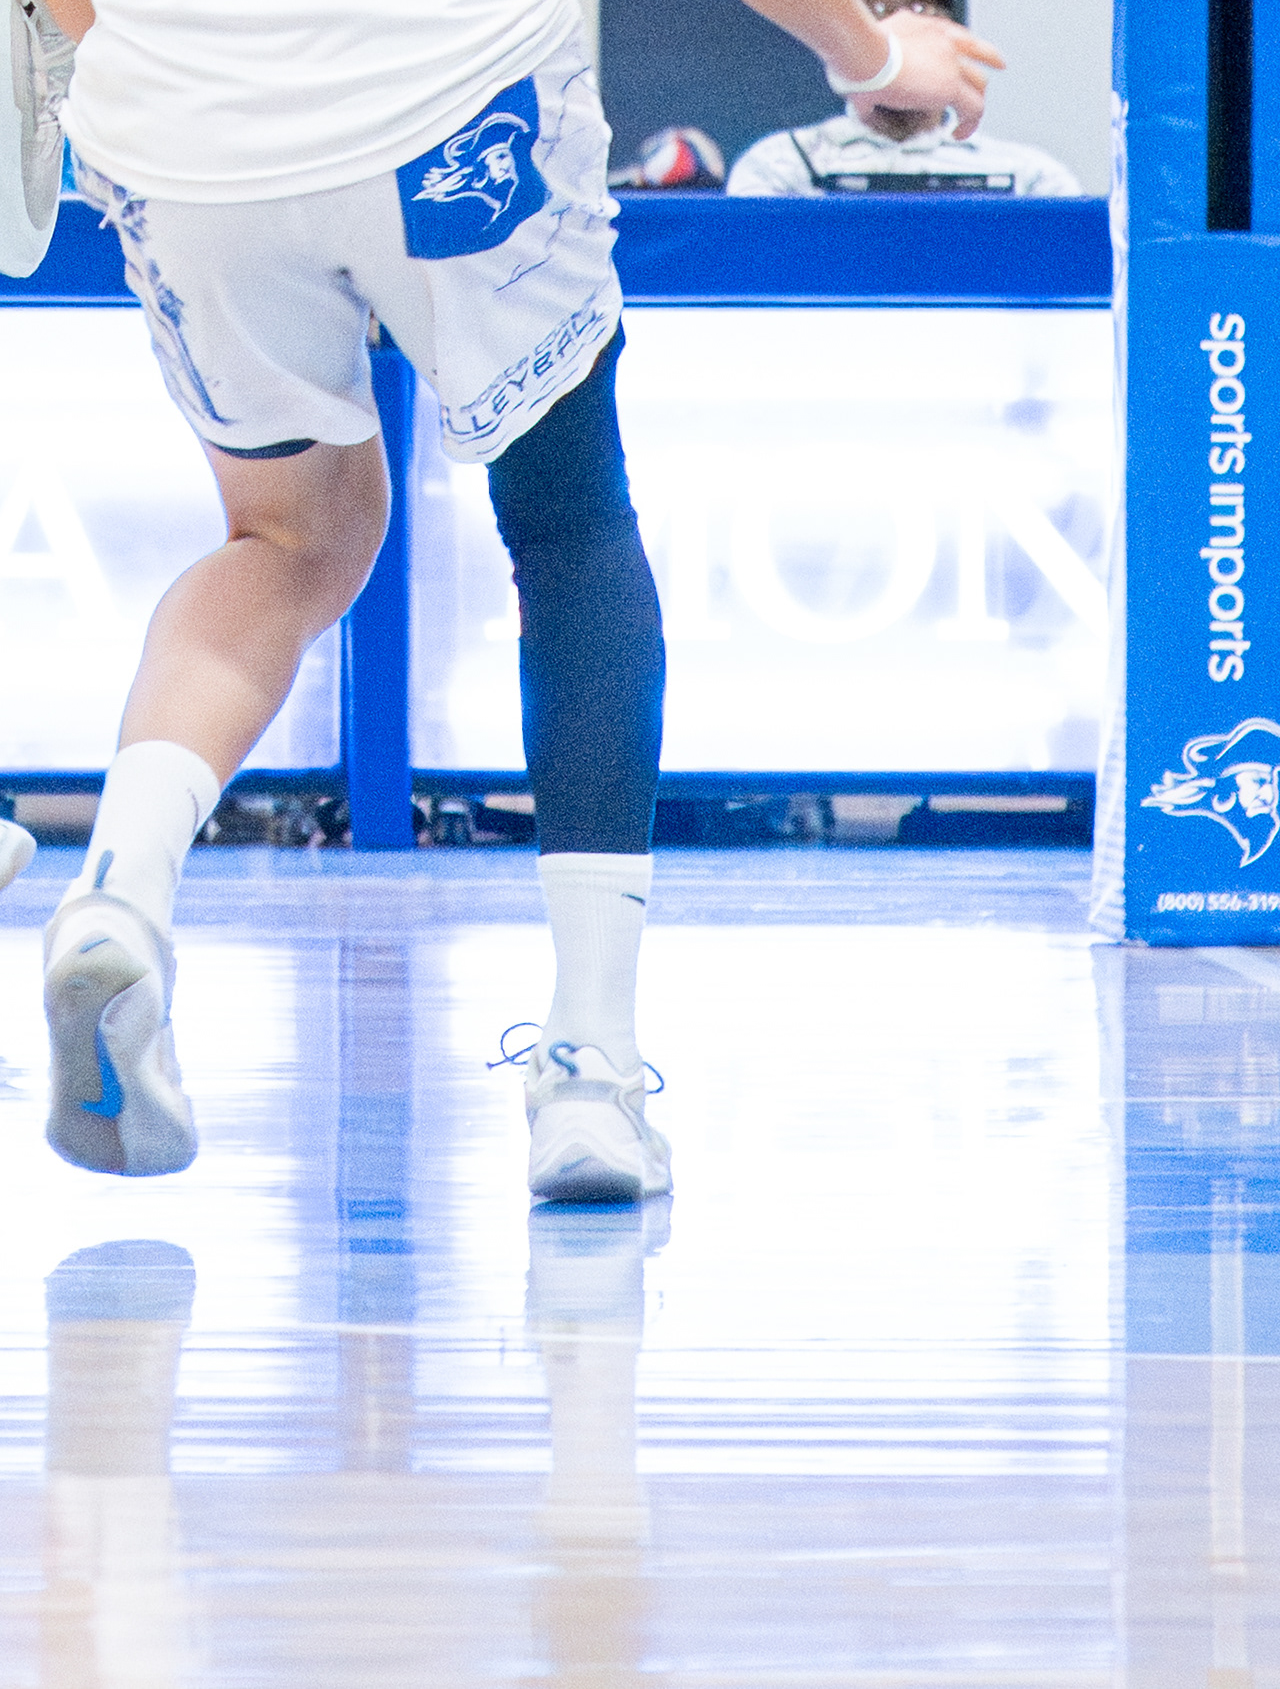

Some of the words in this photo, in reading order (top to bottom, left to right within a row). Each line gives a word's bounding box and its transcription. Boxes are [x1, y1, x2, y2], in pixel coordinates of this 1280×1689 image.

[1200, 311, 1253, 476] sports
[1200, 482, 1253, 684] imports
[1156, 893, 1205, 913] (800)
